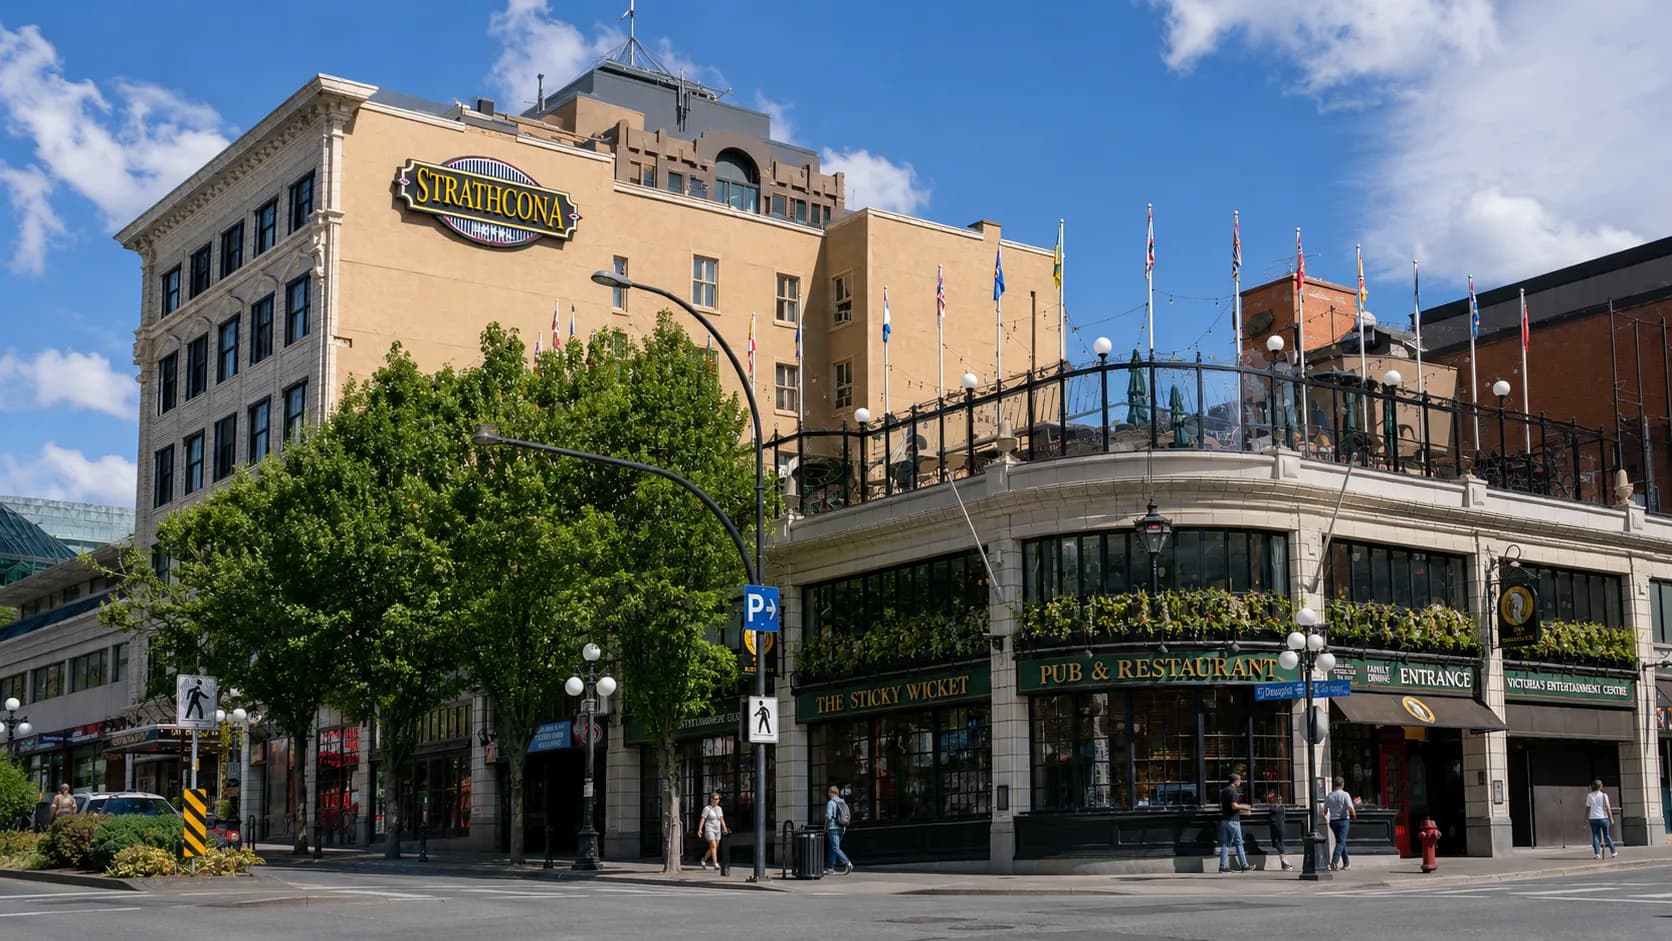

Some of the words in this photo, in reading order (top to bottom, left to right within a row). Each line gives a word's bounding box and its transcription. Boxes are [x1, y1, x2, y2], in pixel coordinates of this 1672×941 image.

[416, 167, 564, 230] STRATHCONA
[748, 593, 764, 622] P
[1040, 662, 1083, 684] PUB
[1091, 661, 1110, 681] &
[1117, 657, 1277, 680] RESTAURANT
[1400, 667, 1472, 688] ENTRANCE
[815, 694, 845, 714] THE
[850, 686, 900, 710] STICKY
[906, 675, 969, 701] WICKET
[1547, 680, 1601, 695] ENTERTAINMENT
